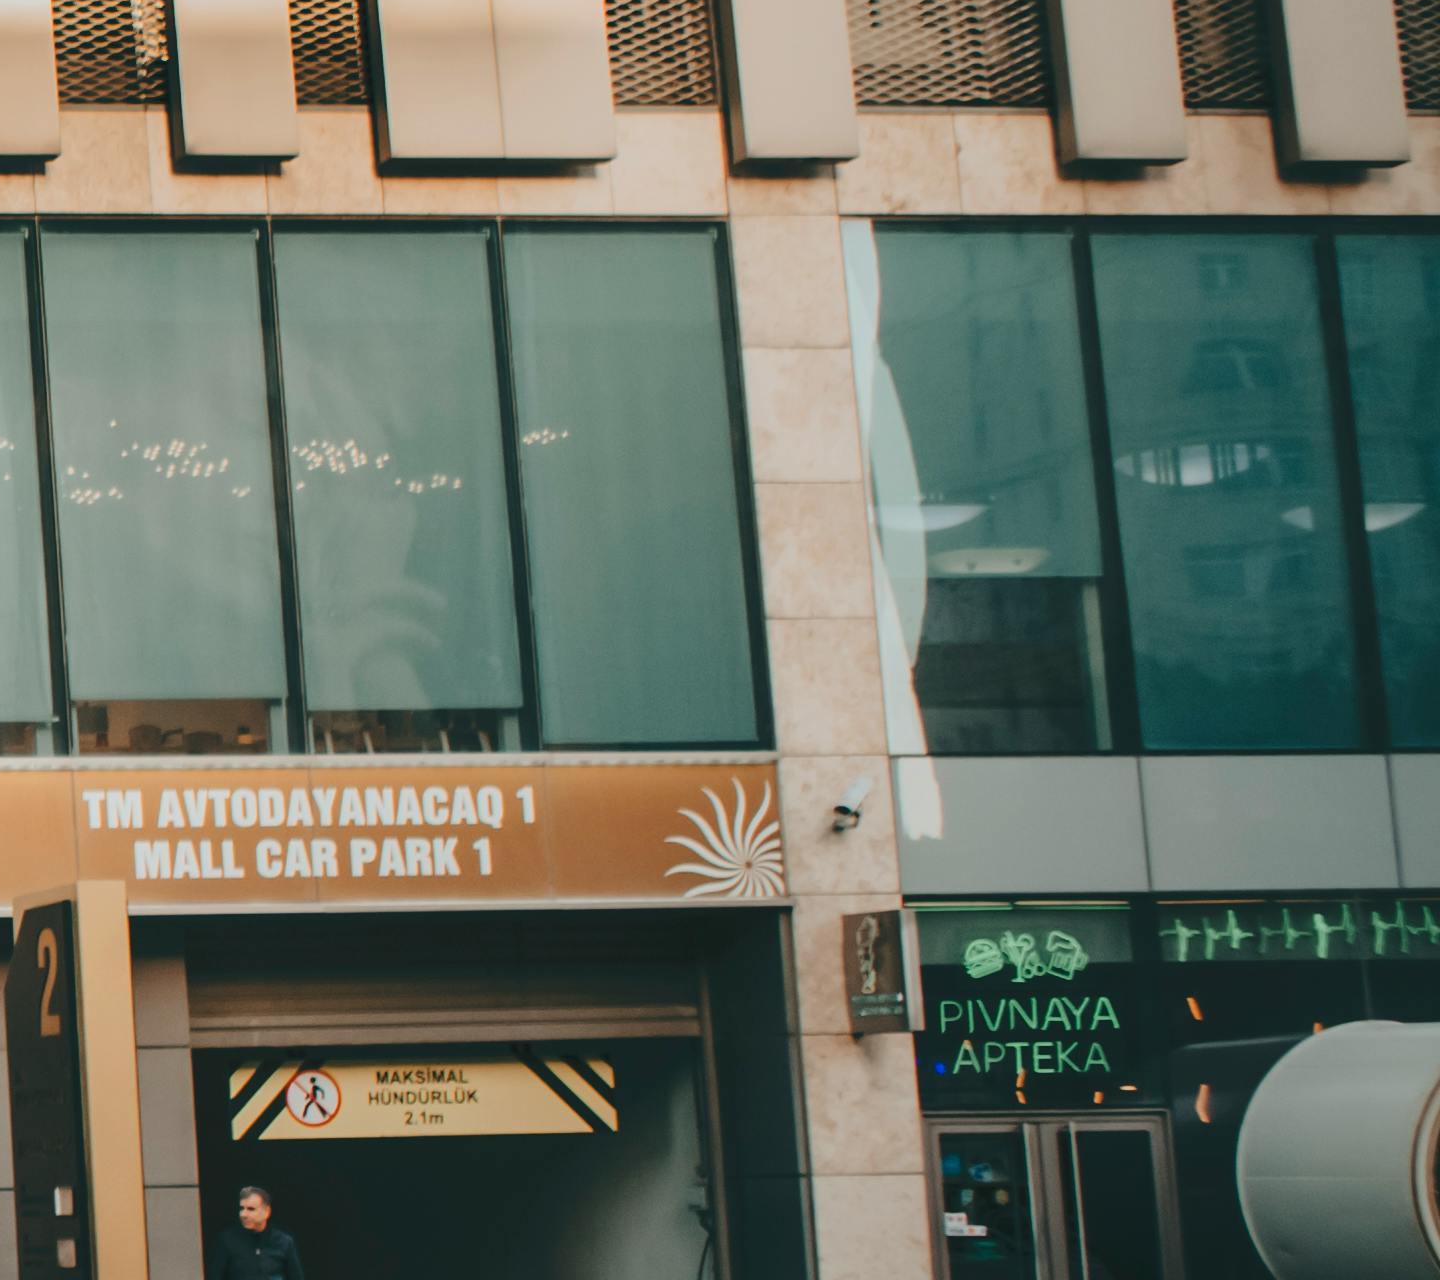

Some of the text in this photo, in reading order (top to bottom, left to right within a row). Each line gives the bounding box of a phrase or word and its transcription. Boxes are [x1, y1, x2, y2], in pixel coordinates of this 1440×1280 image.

[83, 785, 535, 829] TM AVTODAYANACAQ 1
[134, 837, 492, 880] MALL CAR PARK 1
[37, 927, 61, 1037] 2
[940, 996, 1121, 1034] PIVNAYA
[376, 1066, 468, 1084] MAKSİMAL
[952, 1040, 1111, 1075] APTEKA
[368, 1088, 478, 1106] HÜNDÜRLÜK
[405, 1111, 444, 1126] 2.1m
